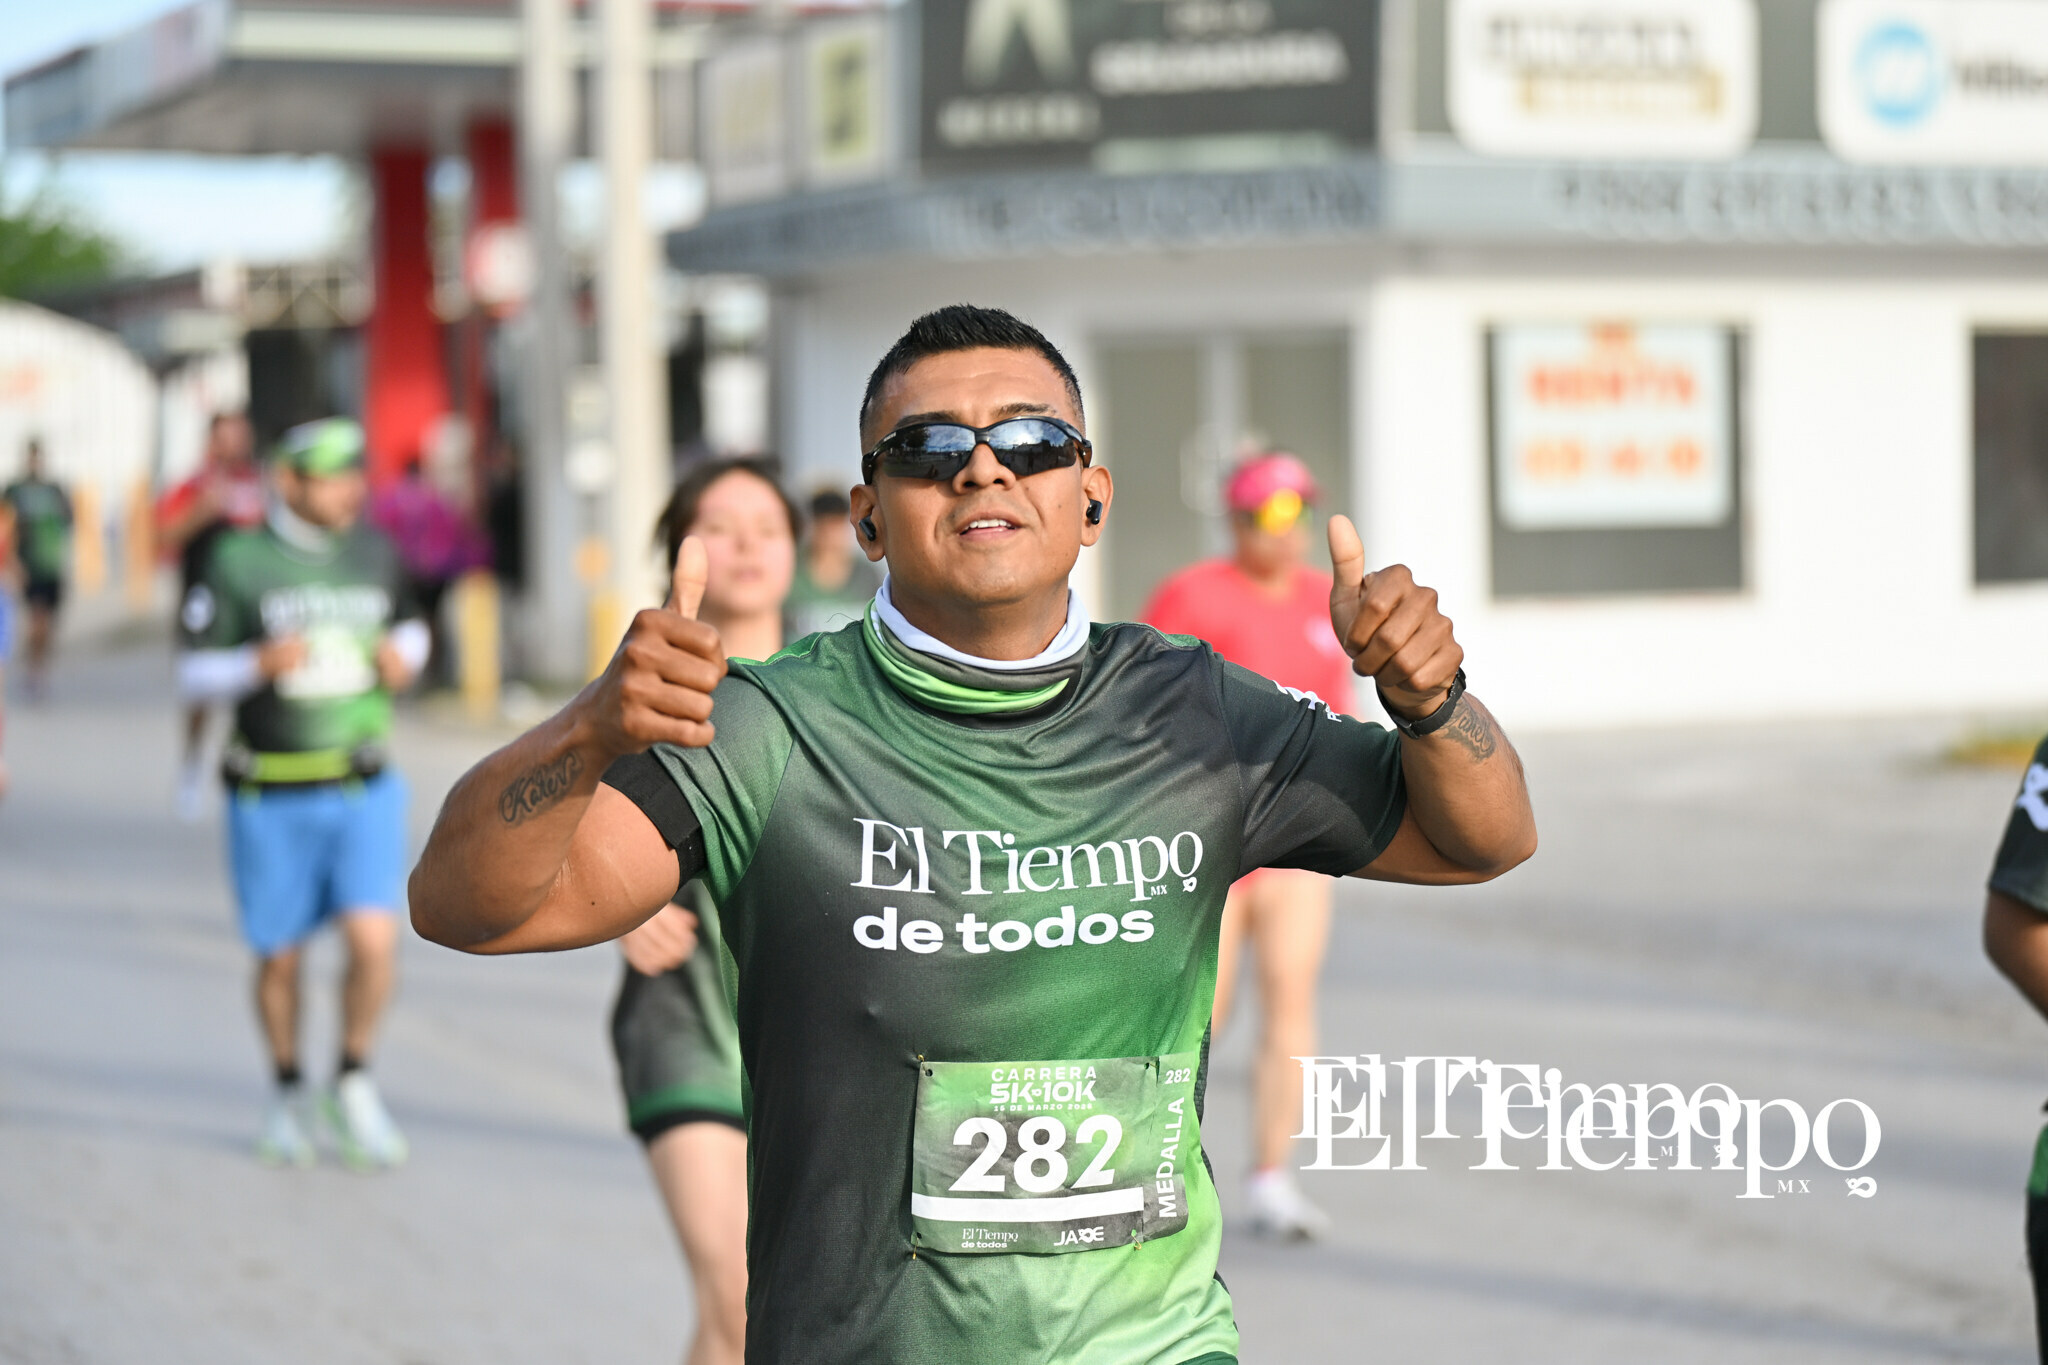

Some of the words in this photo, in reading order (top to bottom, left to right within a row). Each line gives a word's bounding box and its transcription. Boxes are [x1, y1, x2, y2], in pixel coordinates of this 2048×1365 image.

[850, 817, 935, 895] El
[942, 830, 1203, 902] Tiempo
[1150, 884, 1167, 897] MX
[853, 906, 944, 954] de
[956, 905, 1155, 954] todos
[991, 1066, 1097, 1081] CARRERA
[1164, 1068, 1191, 1084] 282
[948, 1114, 1123, 1193] 282
[1155, 1097, 1185, 1218] MEDALLA
[962, 1228, 975, 1240] El
[976, 1228, 1019, 1242] Tiempo
